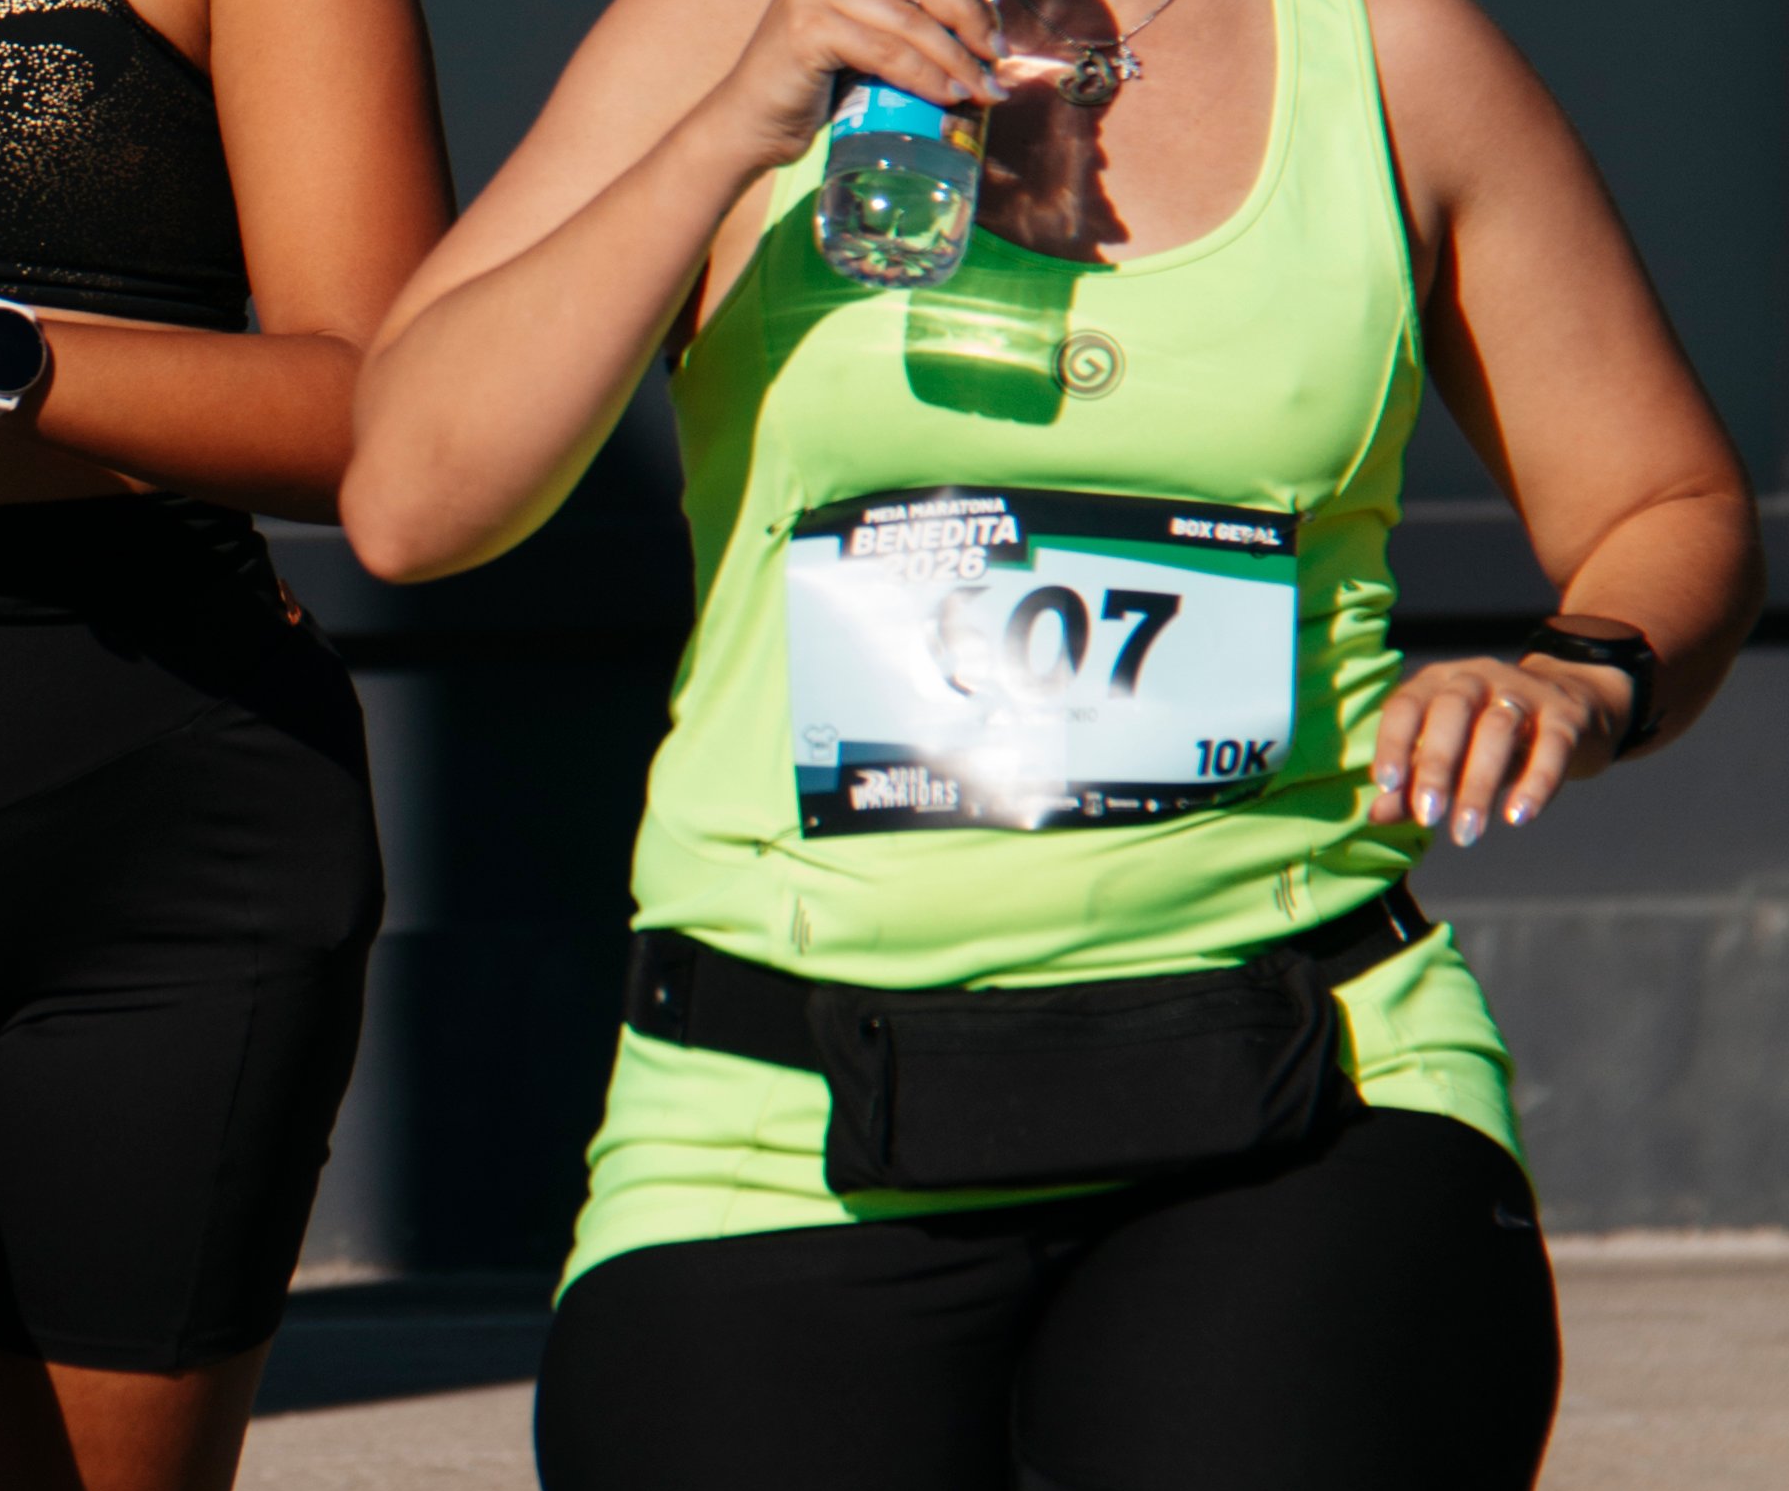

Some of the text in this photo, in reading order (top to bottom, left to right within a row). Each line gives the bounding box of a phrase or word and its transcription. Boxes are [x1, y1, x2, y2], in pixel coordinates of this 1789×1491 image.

[863, 497, 1008, 524] MEIA MARATONA
[850, 514, 1020, 556] BENEDITA
[1169, 516, 1283, 546] BOX GERAL
[885, 545, 989, 582] 2026
[1196, 738, 1278, 778] 10K
